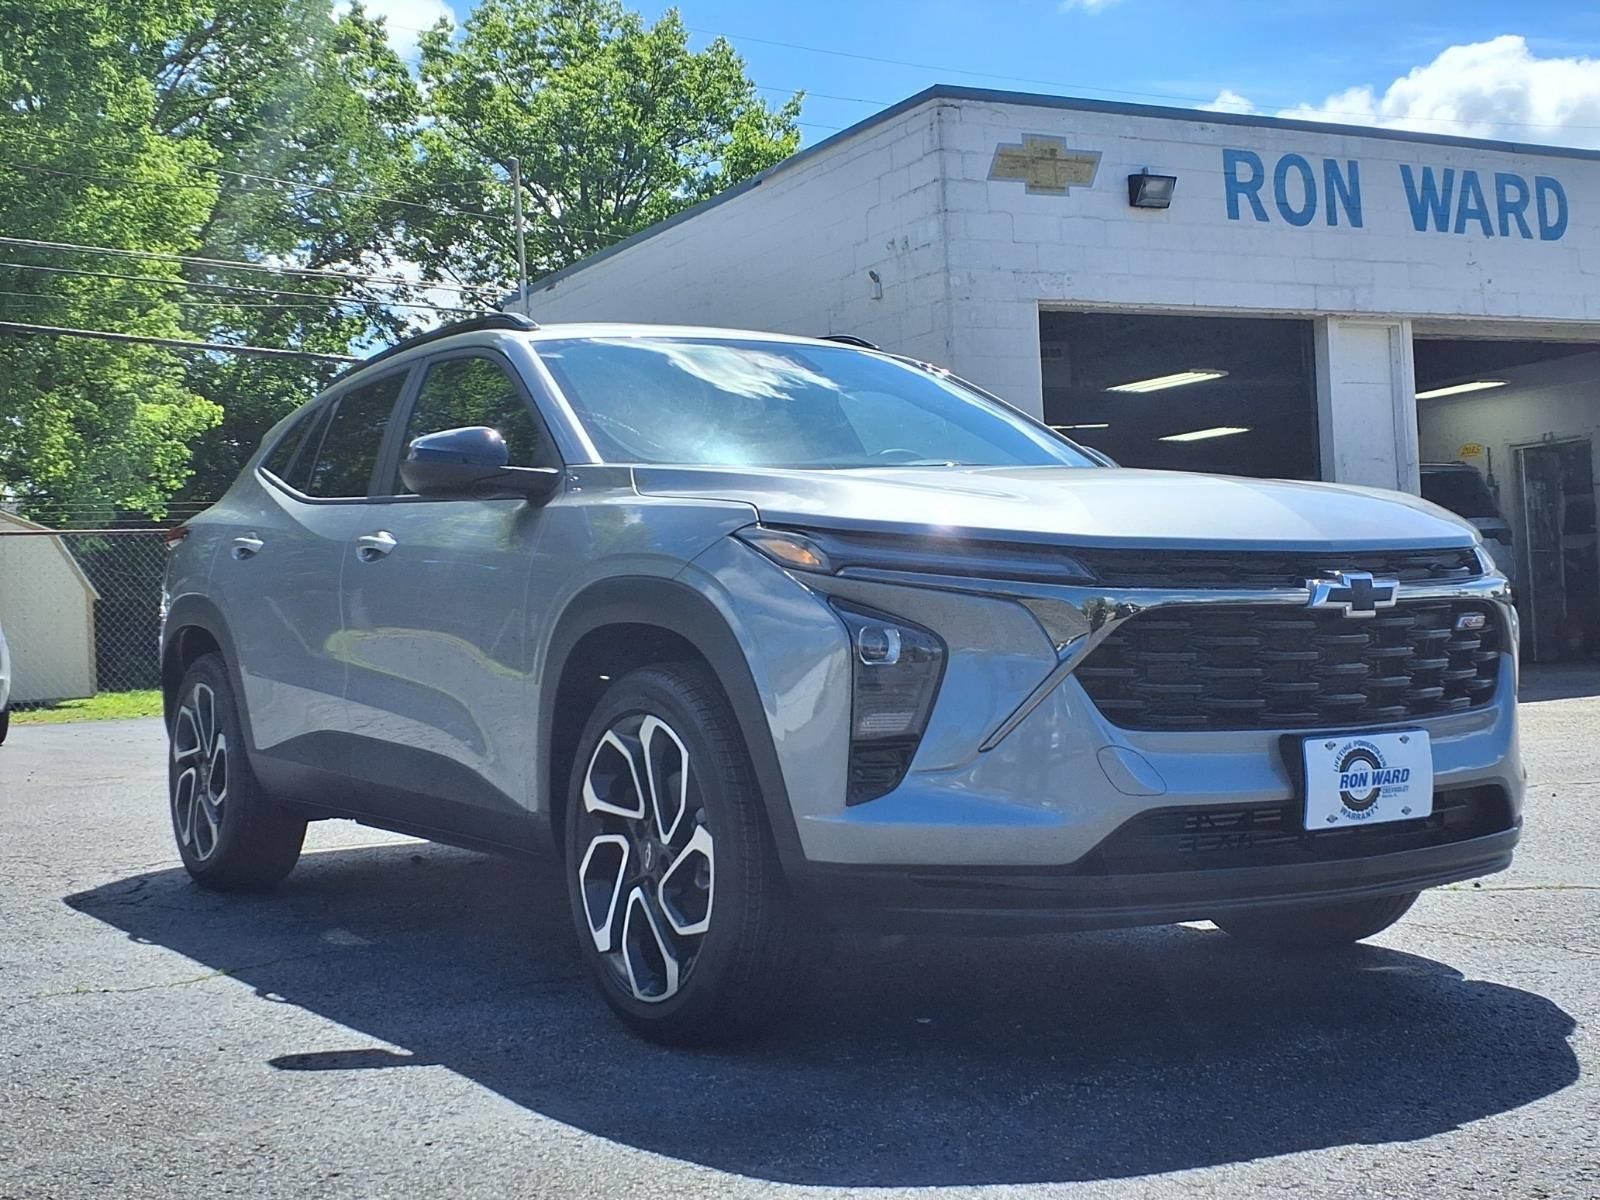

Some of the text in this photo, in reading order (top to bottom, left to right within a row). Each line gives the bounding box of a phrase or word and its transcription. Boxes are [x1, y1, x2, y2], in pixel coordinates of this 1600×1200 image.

[1222, 148, 1568, 241] RON WARD
[1457, 612, 1486, 629] RS
[1340, 768, 1410, 789] RON WARD
[1340, 802, 1379, 820] WARRANTY
